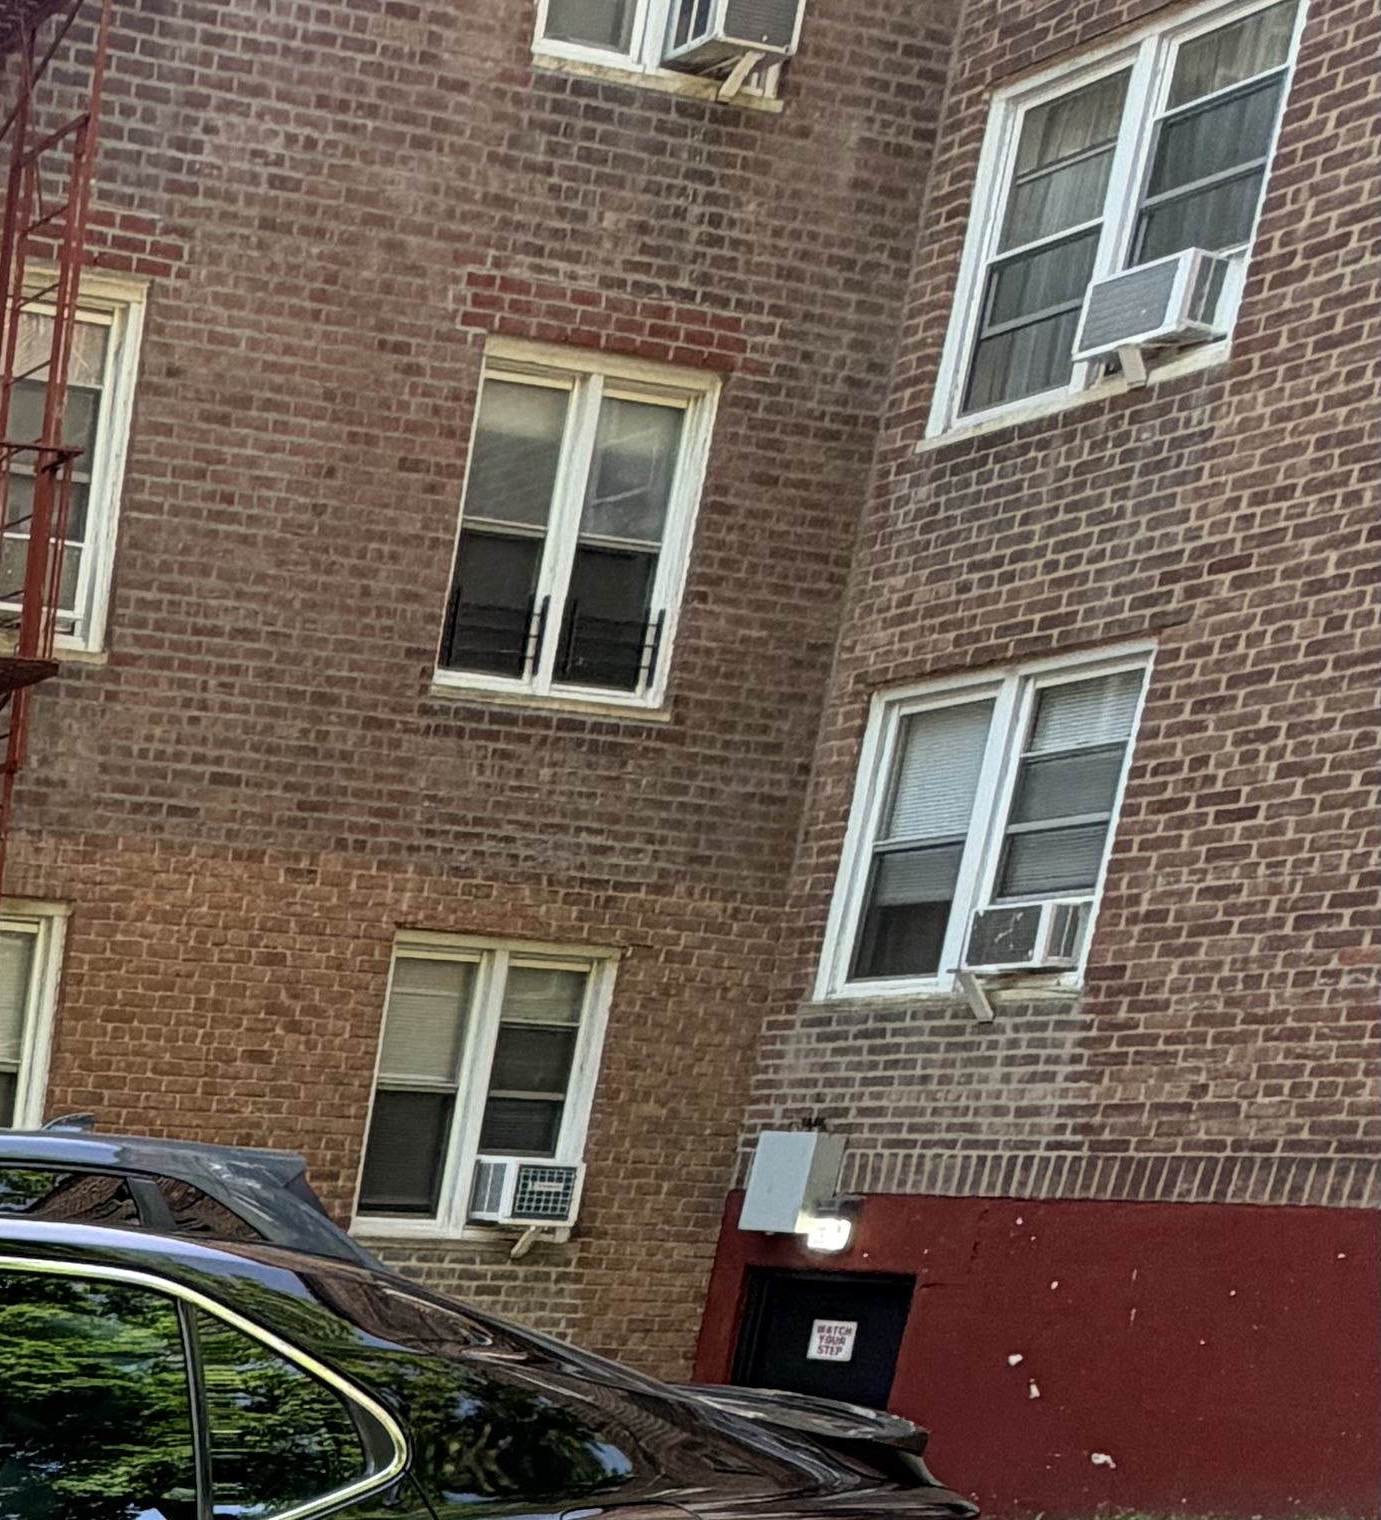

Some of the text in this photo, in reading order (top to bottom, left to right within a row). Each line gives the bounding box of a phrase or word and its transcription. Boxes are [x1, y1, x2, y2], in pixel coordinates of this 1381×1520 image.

[817, 1325, 852, 1336] WATCH
[819, 1334, 846, 1345] YOUR
[816, 1345, 843, 1356] STEP
